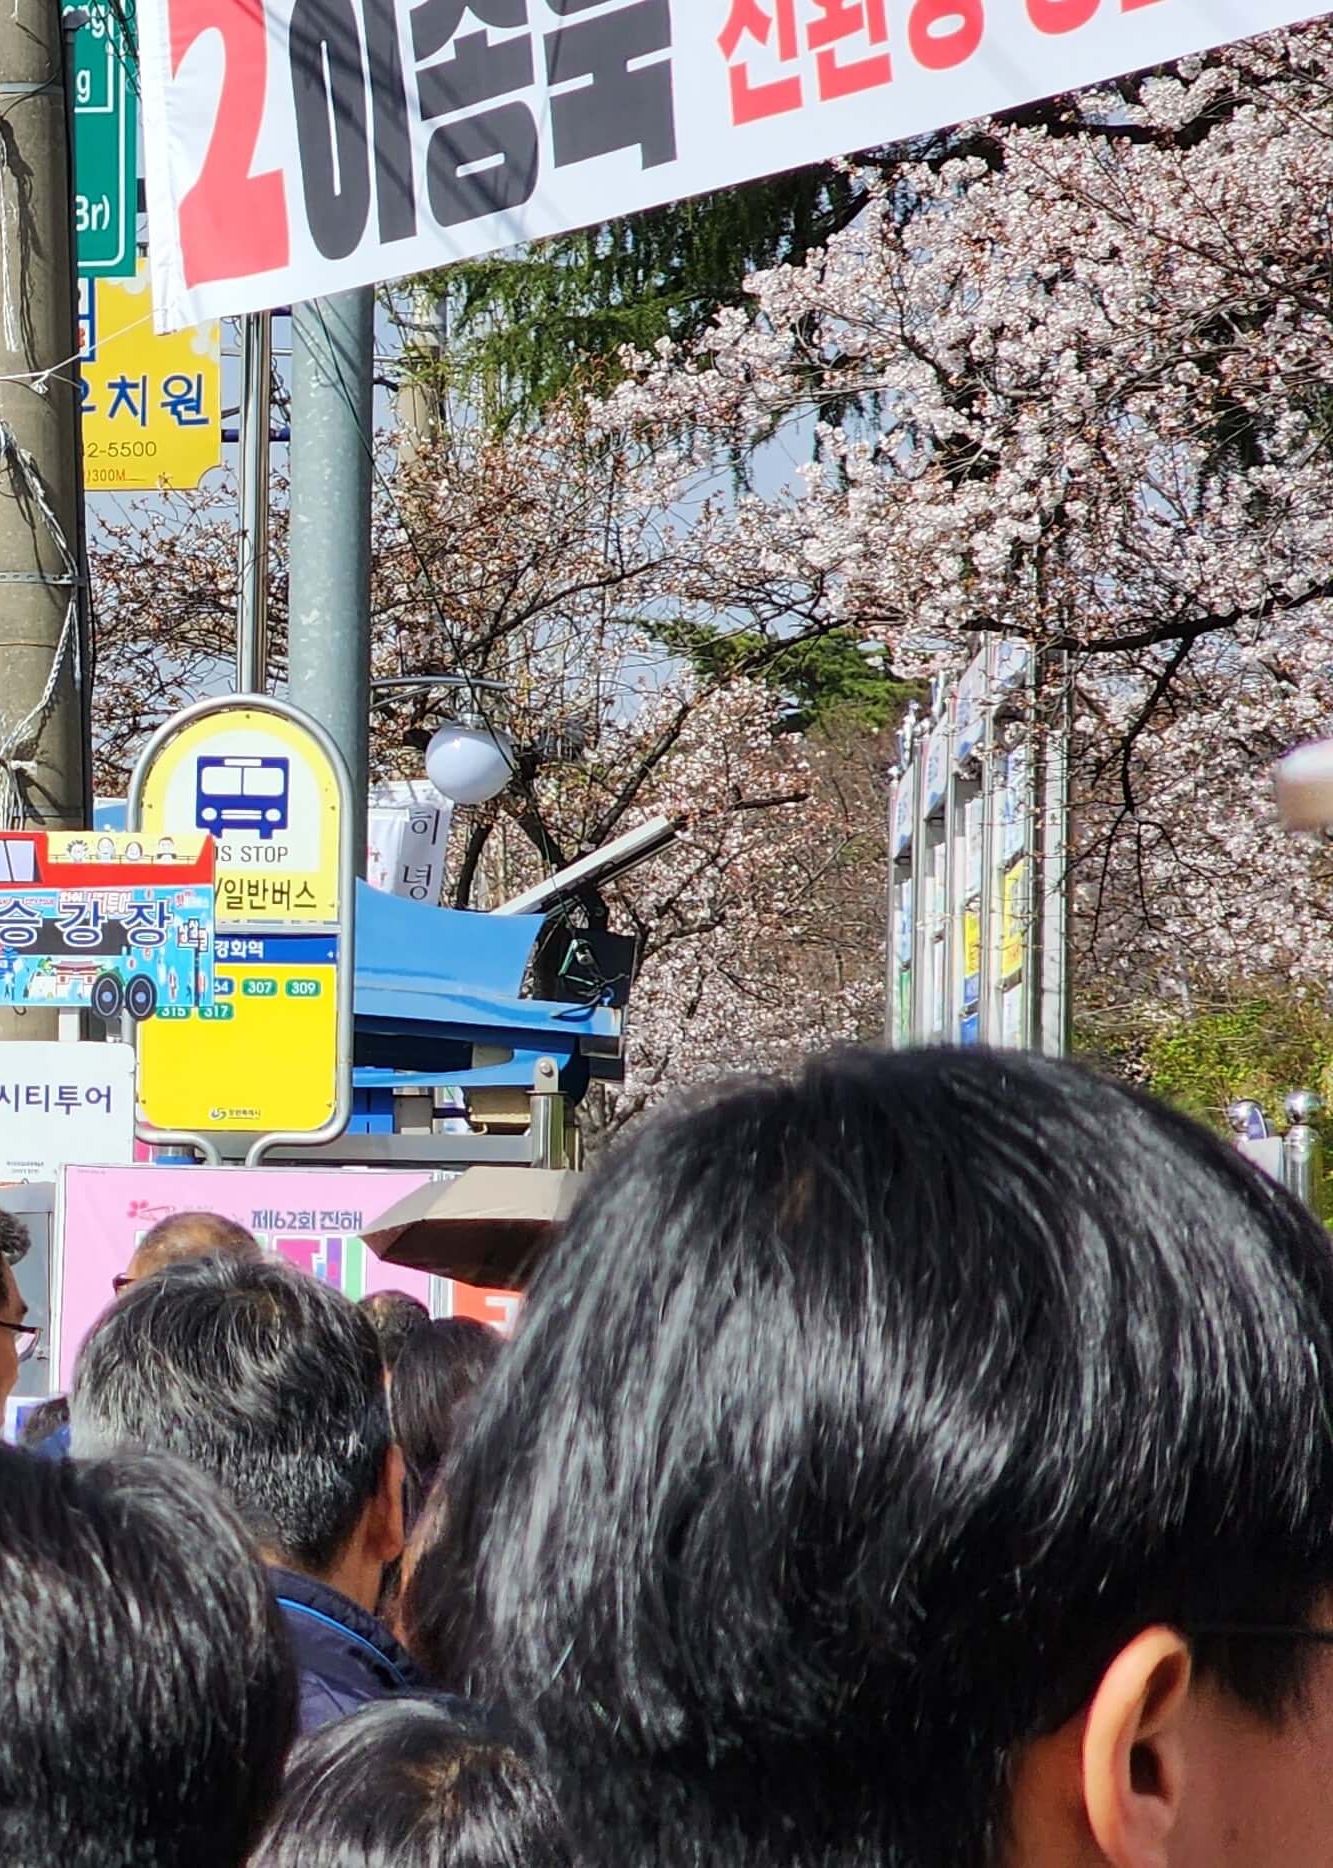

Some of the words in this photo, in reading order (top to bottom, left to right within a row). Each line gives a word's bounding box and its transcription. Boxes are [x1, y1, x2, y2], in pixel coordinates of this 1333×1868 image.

[240, 845, 289, 863] STOP
[215, 939, 264, 959] 경화역
[247, 980, 272, 994] 307
[291, 981, 316, 995] 309
[251, 1209, 316, 1230] 제62회
[320, 1209, 363, 1231] 진해
